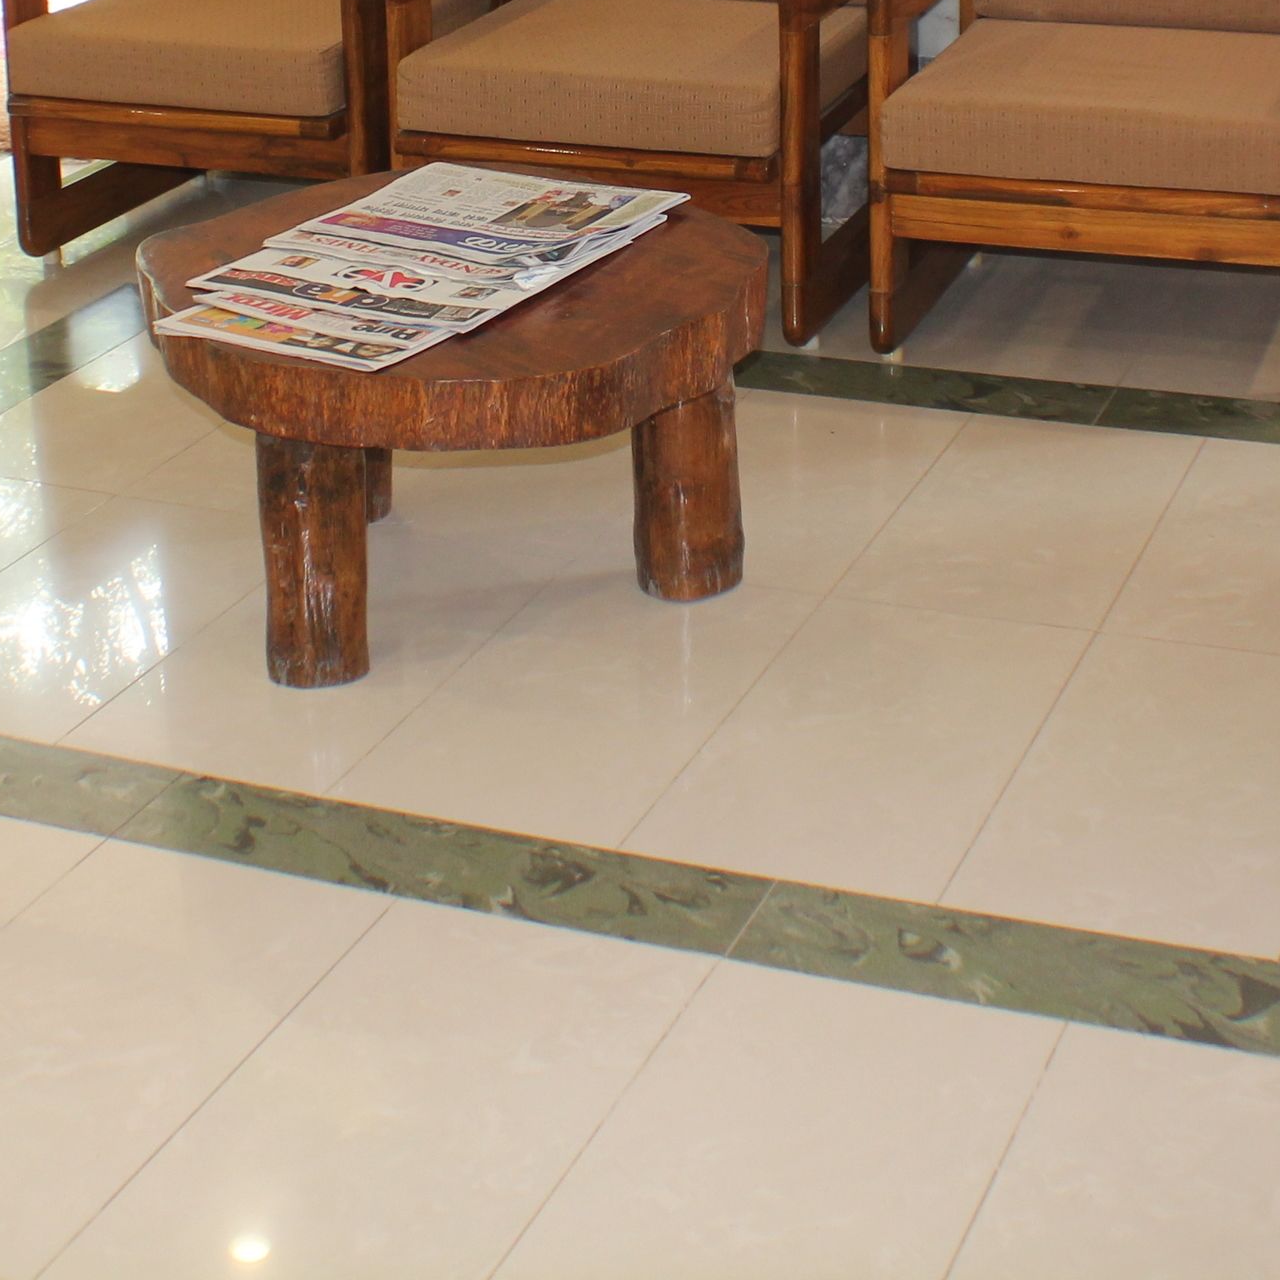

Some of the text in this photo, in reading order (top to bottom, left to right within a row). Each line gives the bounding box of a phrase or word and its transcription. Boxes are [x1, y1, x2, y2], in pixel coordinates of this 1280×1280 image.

[313, 233, 384, 254] TIMES
[416, 254, 509, 275] SUNDAY
[224, 294, 313, 320] Mirror
[292, 283, 390, 311] dna
[351, 323, 420, 341] Pune
